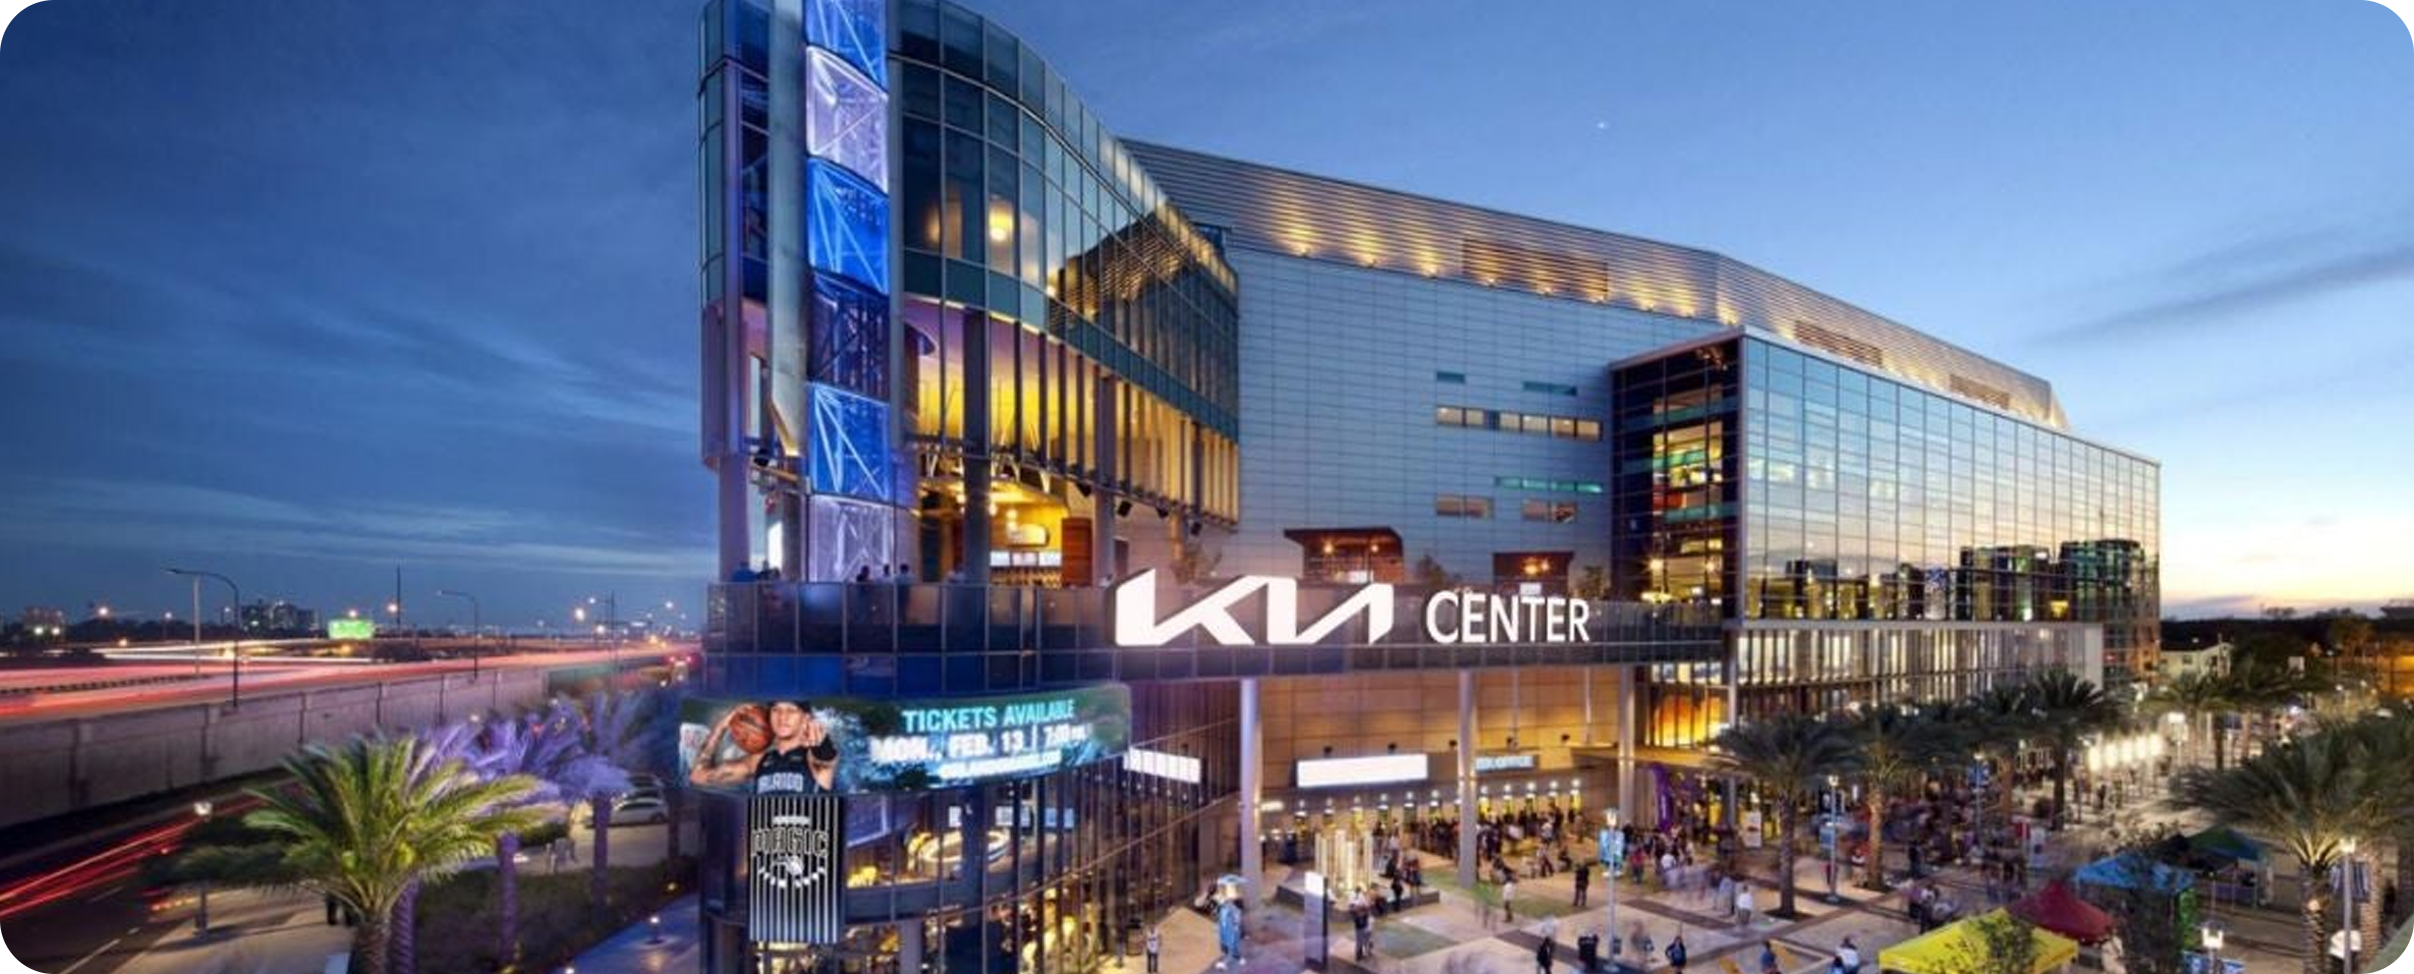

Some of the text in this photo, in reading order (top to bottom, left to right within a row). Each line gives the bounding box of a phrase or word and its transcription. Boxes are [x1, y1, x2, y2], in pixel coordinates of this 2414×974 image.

[1426, 590, 1591, 644] CENTER
[902, 699, 1076, 733] TICKETS AVAILABLE
[948, 733, 995, 759] FEB.
[1002, 730, 1024, 753] 13
[751, 826, 829, 858] MAGIC
